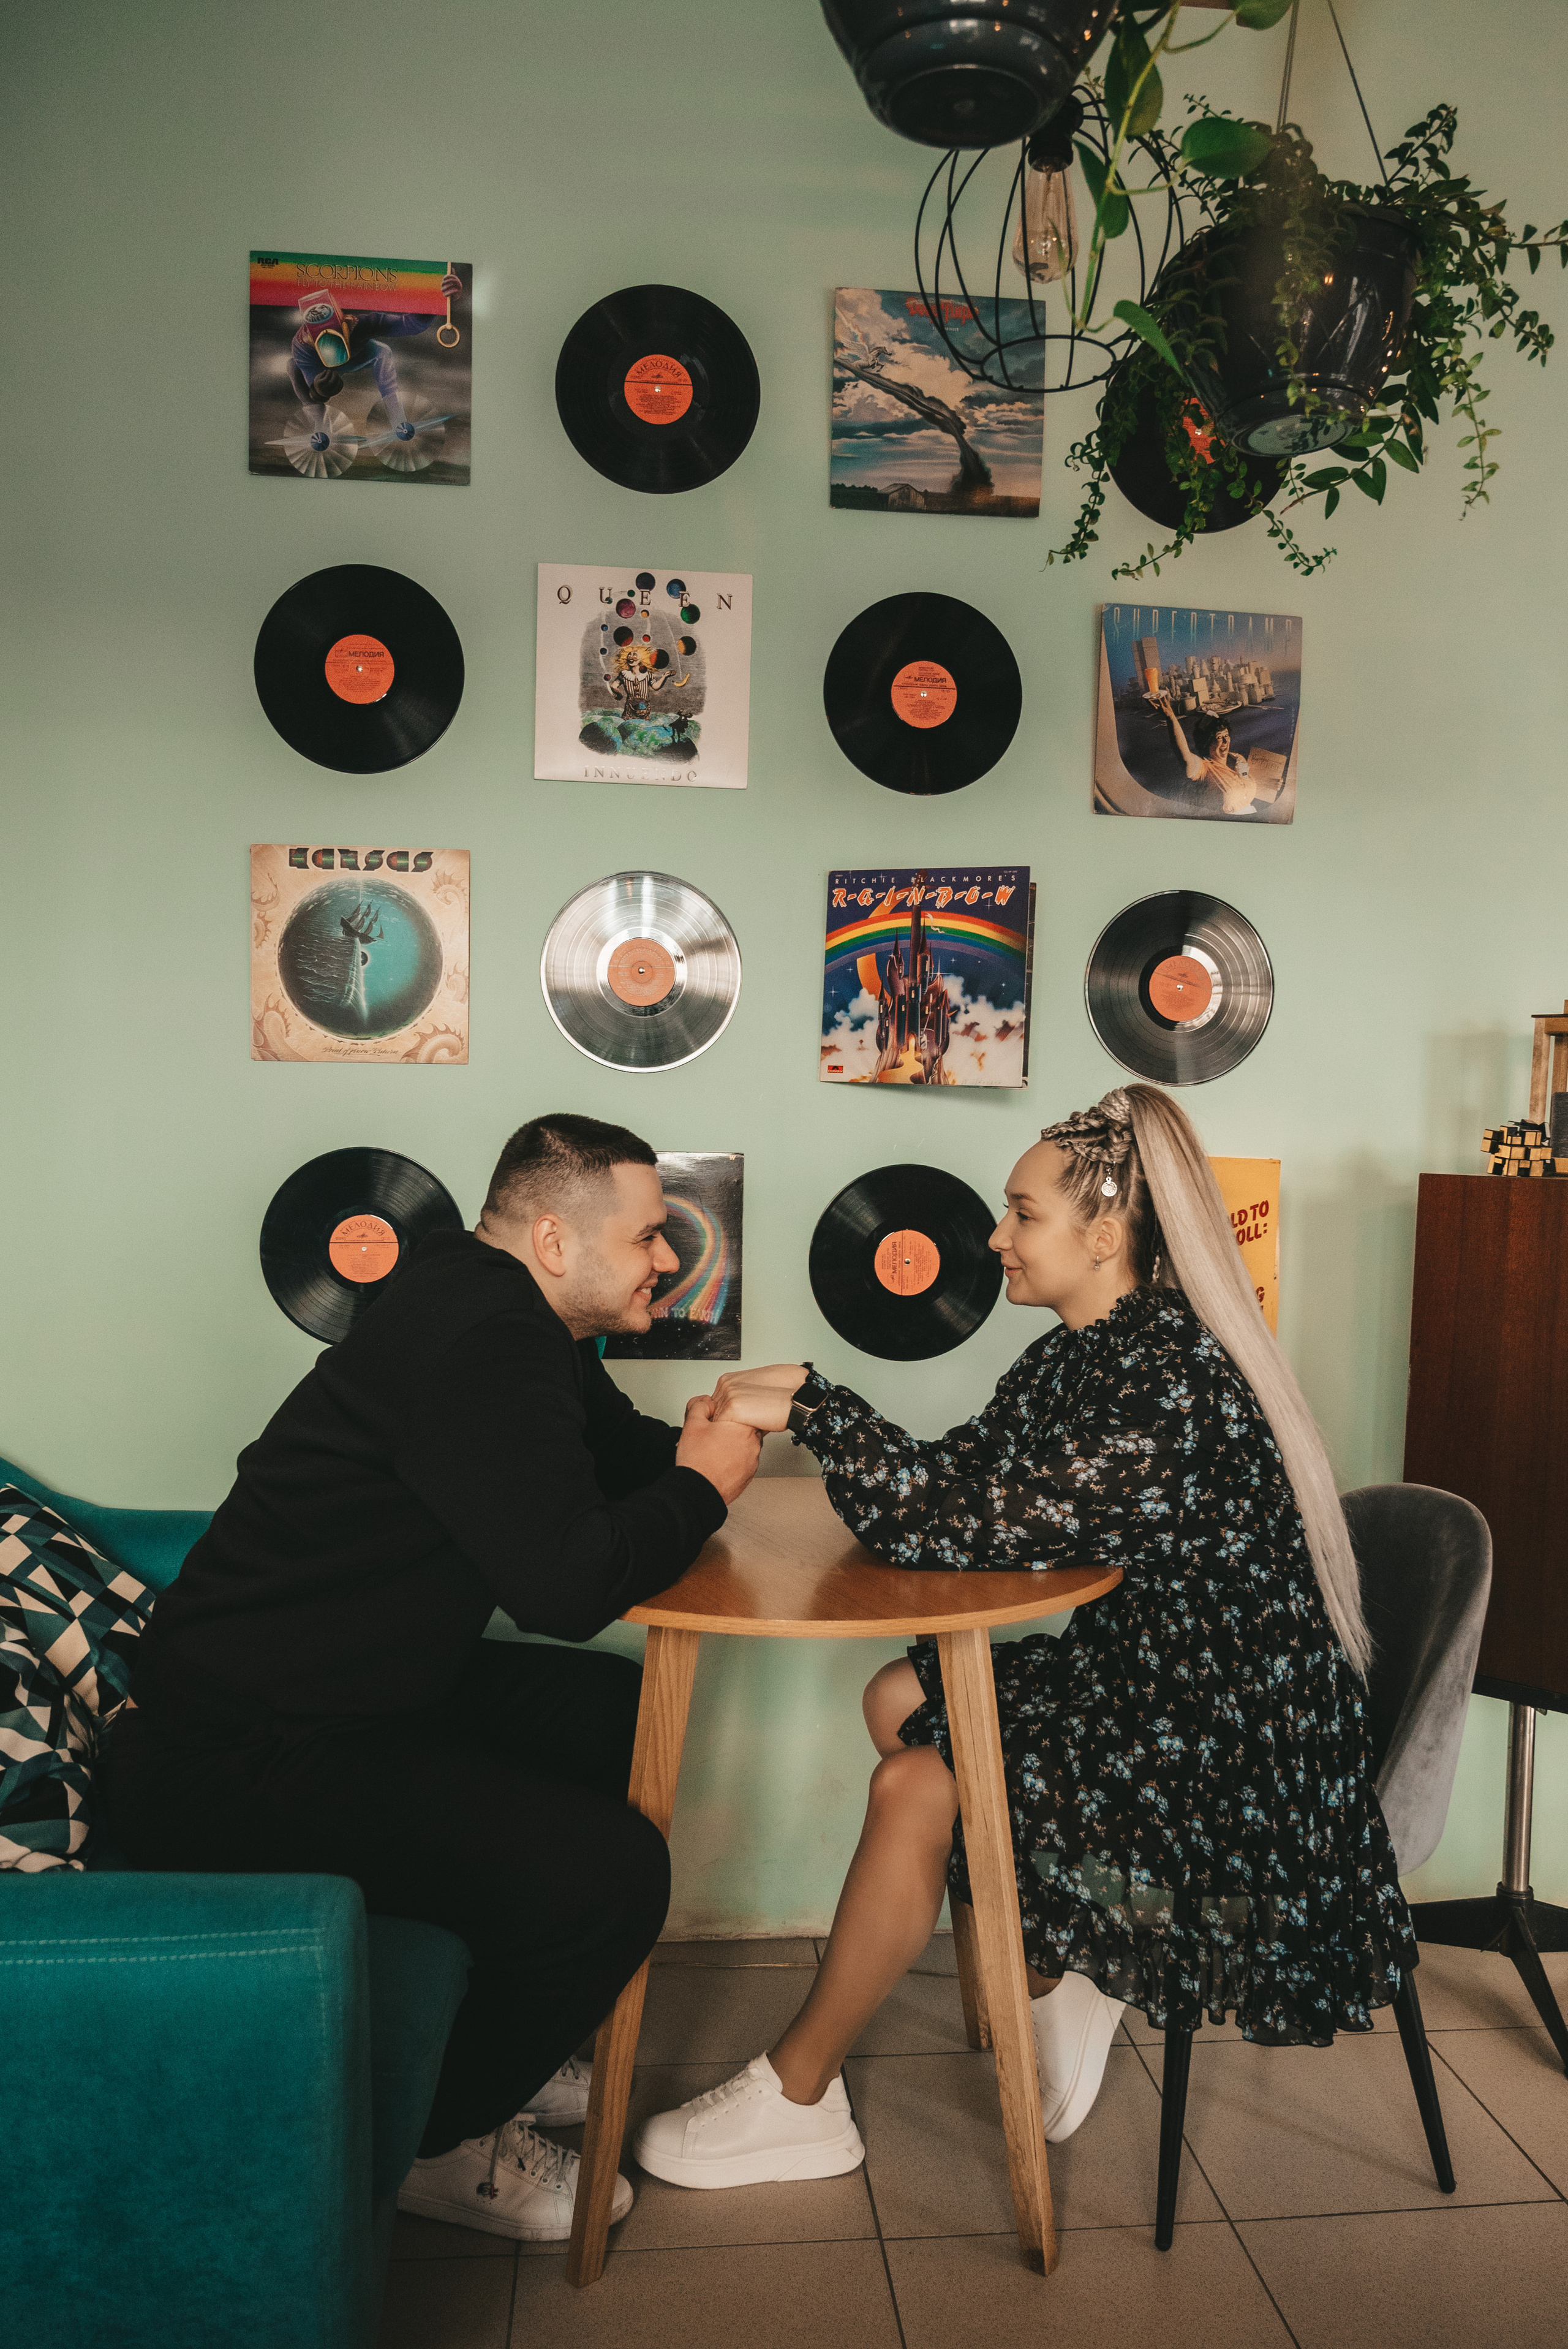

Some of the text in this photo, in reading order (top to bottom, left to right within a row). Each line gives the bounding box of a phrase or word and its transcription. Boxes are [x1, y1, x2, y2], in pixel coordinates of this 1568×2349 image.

[296, 263, 398, 282] SCORPIONS
[296, 278, 311, 287] FLY
[328, 281, 347, 289] THE
[350, 282, 398, 292] RAINBOW
[636, 360, 682, 378] МЕЛОДИЯ
[557, 584, 733, 610] QUEEN
[289, 847, 434, 872] KANSAS
[911, 874, 1016, 883] BLACKMORE'S
[1231, 1200, 1269, 1228] LD TO
[341, 1220, 385, 1236] МЕЛОДИЯ
[1236, 1223, 1267, 1246] OLL:
[671, 1307, 685, 1318] TO
